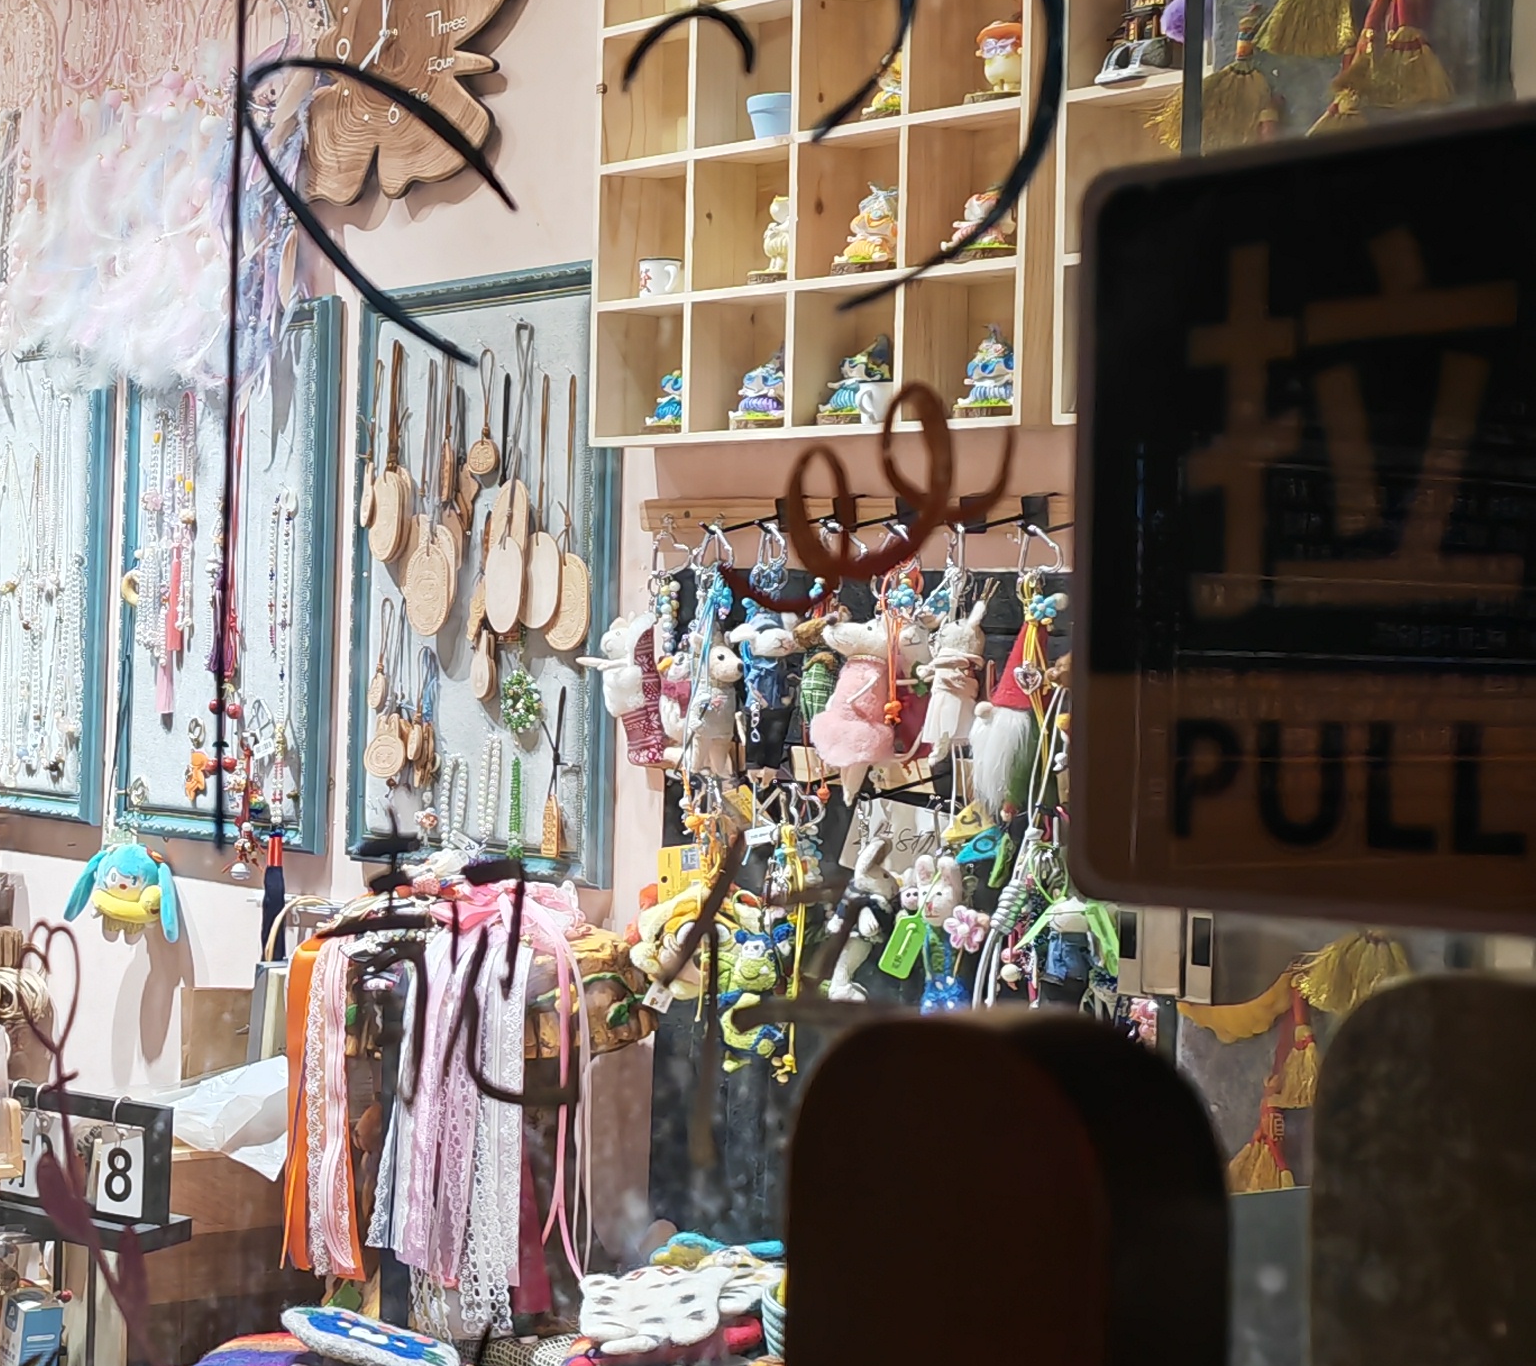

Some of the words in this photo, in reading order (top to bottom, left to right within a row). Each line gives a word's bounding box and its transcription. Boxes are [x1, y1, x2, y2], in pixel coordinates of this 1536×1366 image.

[425, 10, 467, 37] Three
[336, 38, 351, 65] 9
[427, 56, 455, 75] Four
[387, 101, 400, 125] 6
[1186, 223, 1524, 621] 拉
[1168, 717, 1528, 856] PULL
[104, 1147, 132, 1202] 8
